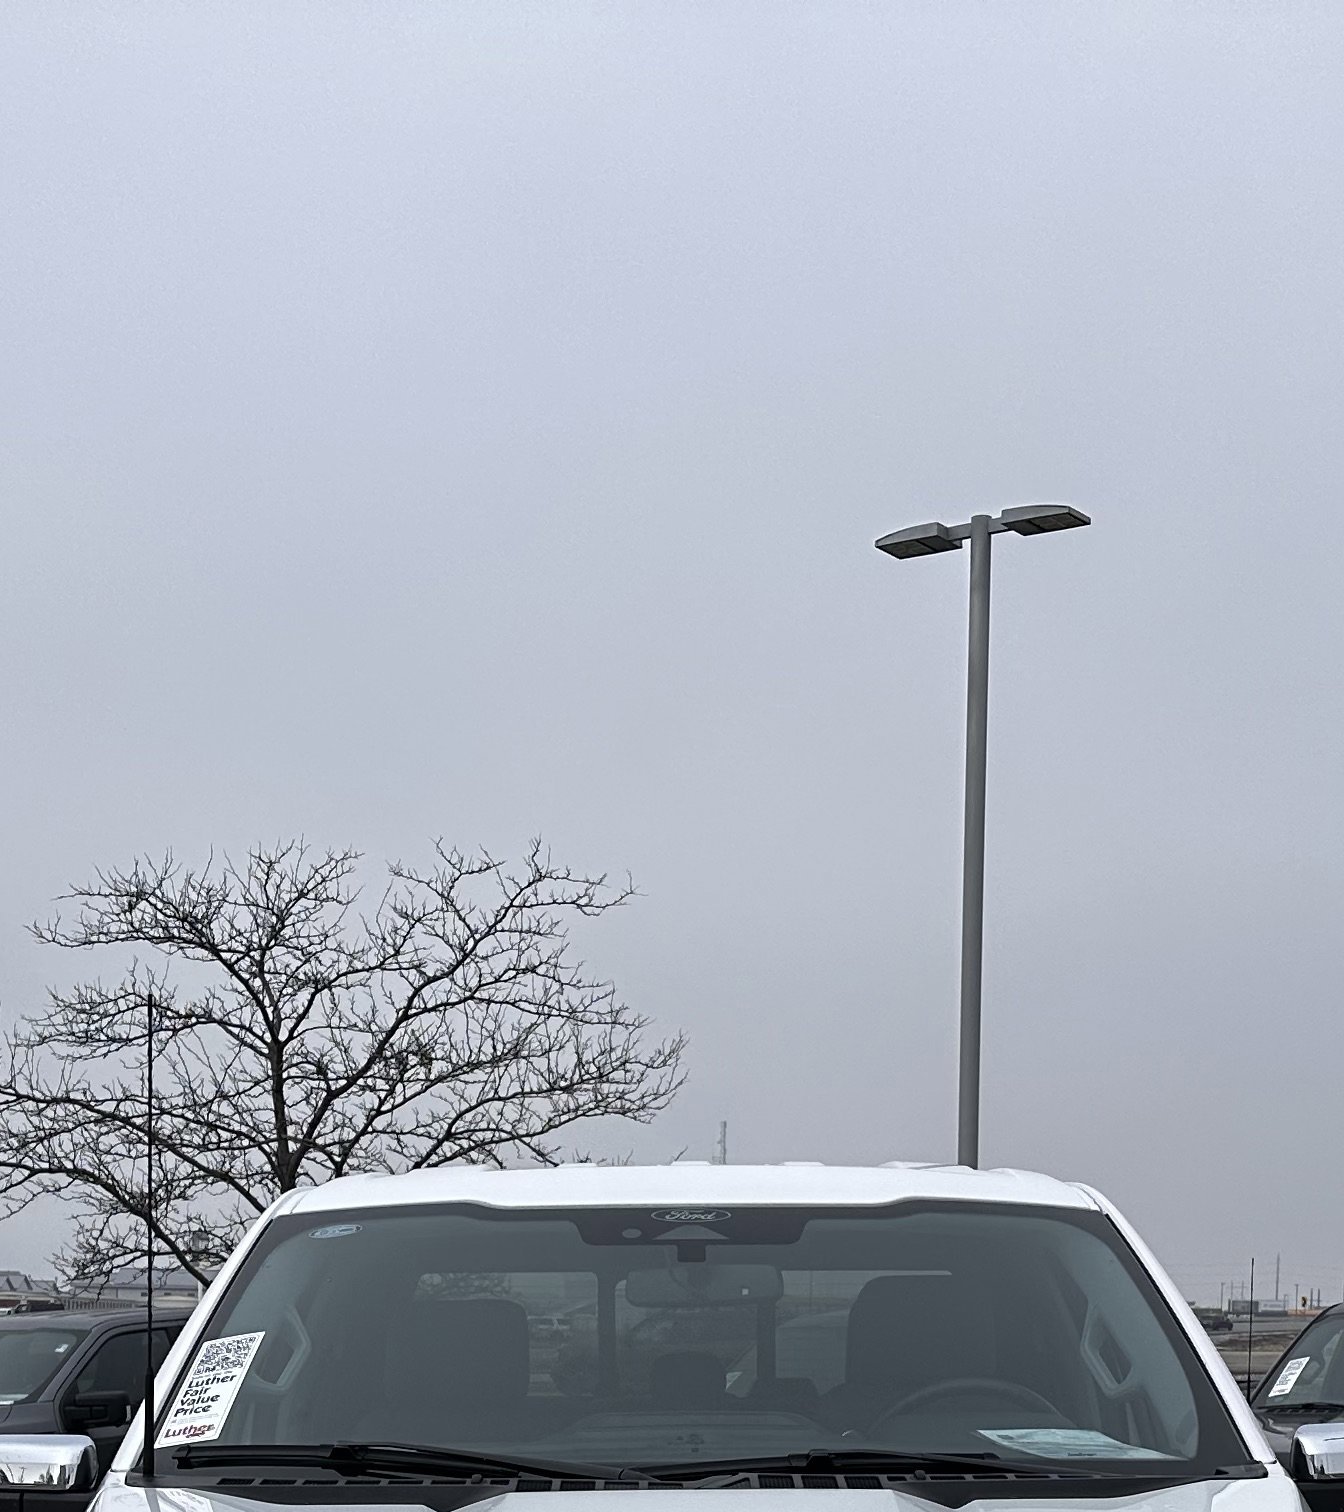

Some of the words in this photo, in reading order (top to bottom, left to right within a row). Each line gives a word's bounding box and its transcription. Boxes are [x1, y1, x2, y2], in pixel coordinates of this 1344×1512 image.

[665, 1210, 717, 1220] Ford
[187, 1373, 237, 1388] Luther
[183, 1386, 211, 1399] Fair
[180, 1394, 220, 1407] Value
[173, 1404, 212, 1418] Price
[164, 1423, 216, 1439] Luther
